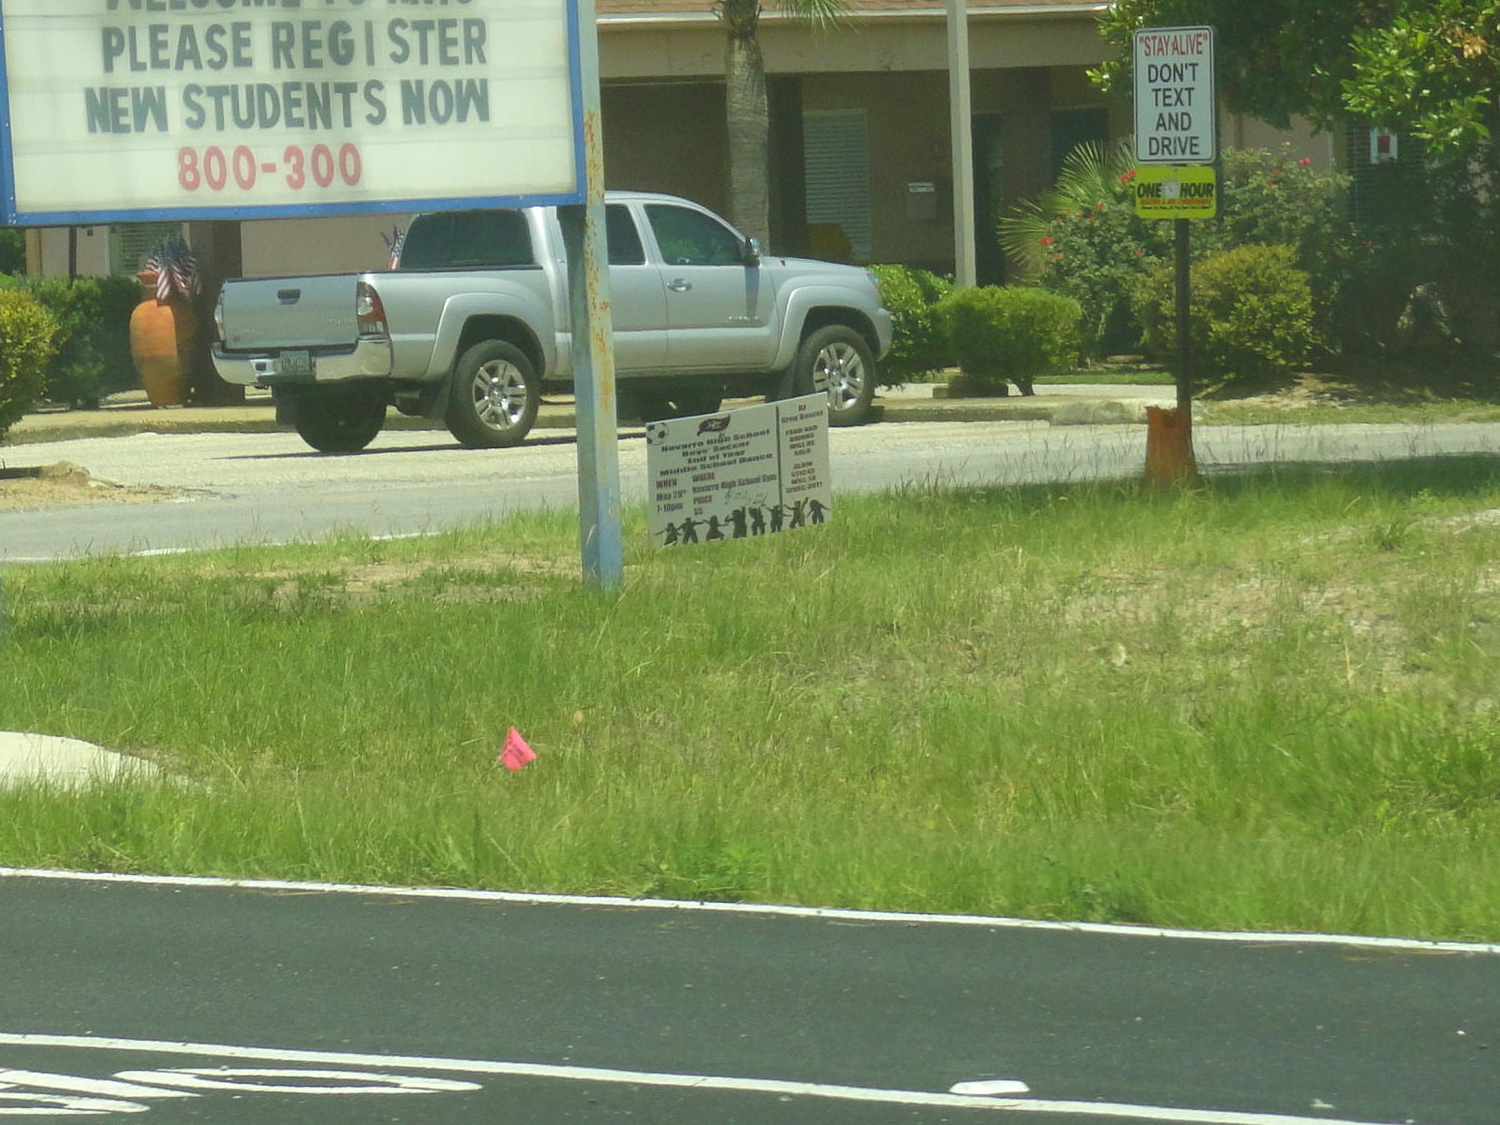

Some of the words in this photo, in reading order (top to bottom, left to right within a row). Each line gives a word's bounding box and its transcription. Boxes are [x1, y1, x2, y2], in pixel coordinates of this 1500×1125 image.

[102, 23, 253, 73] PLEASE
[1147, 62, 1199, 83] DON'T
[84, 85, 169, 135] NEW
[182, 78, 387, 132] STUDENTS
[400, 78, 490, 125] NOW
[1151, 87, 1195, 107] TEXT
[1155, 112, 1192, 132] AND
[1148, 136, 1200, 156] DRIVE
[177, 142, 362, 191] 800-300
[1137, 182, 1163, 199] ONE
[1180, 182, 1214, 199] HOUR
[733, 429, 770, 441] School
